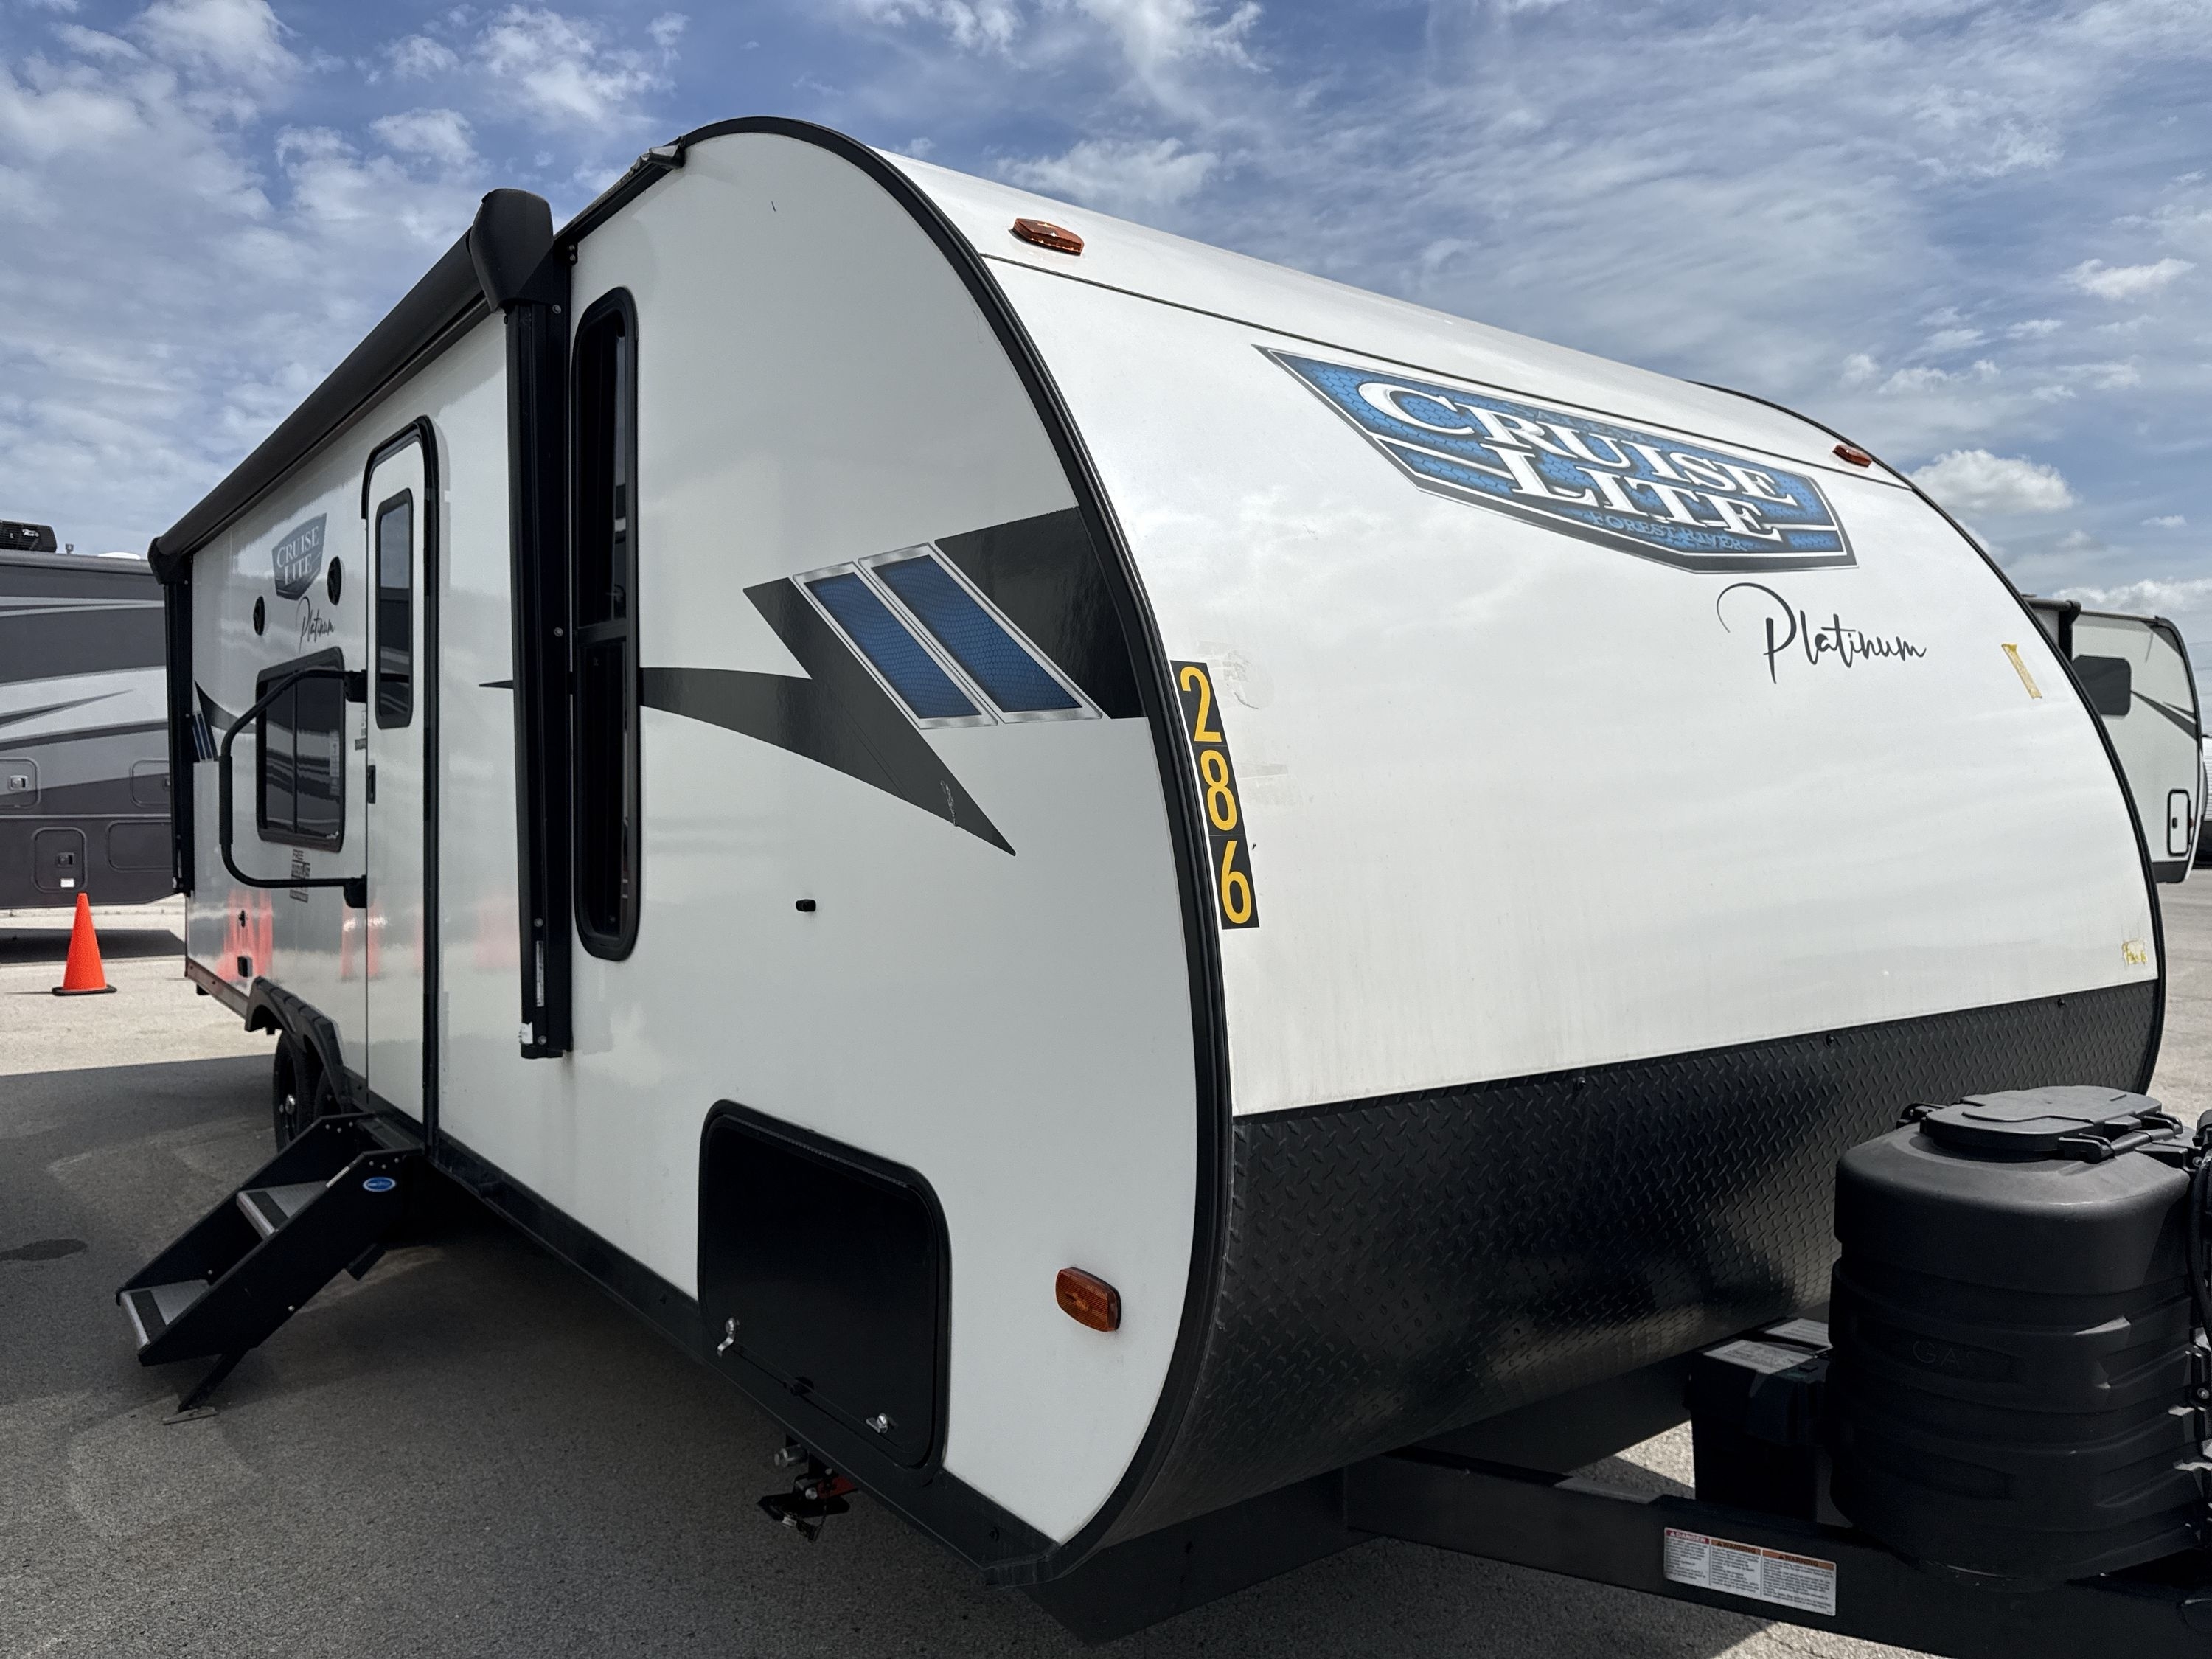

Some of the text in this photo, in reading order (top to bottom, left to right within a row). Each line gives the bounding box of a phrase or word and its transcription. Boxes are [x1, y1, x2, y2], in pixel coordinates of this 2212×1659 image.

[1358, 382, 1797, 506] CRUISE
[1480, 442, 1783, 542] LITE
[276, 526, 319, 568] CRUISE
[1589, 512, 1747, 552] FOREST RIVER
[283, 554, 312, 585] LITE
[296, 596, 335, 654] Platinum
[1716, 582, 1927, 684] Platinum
[1180, 666, 1252, 924] 286
[1675, 1531, 1705, 1543] DANGER
[1722, 1541, 1756, 1554] WARNING
[1784, 1554, 1819, 1568] WARNING
